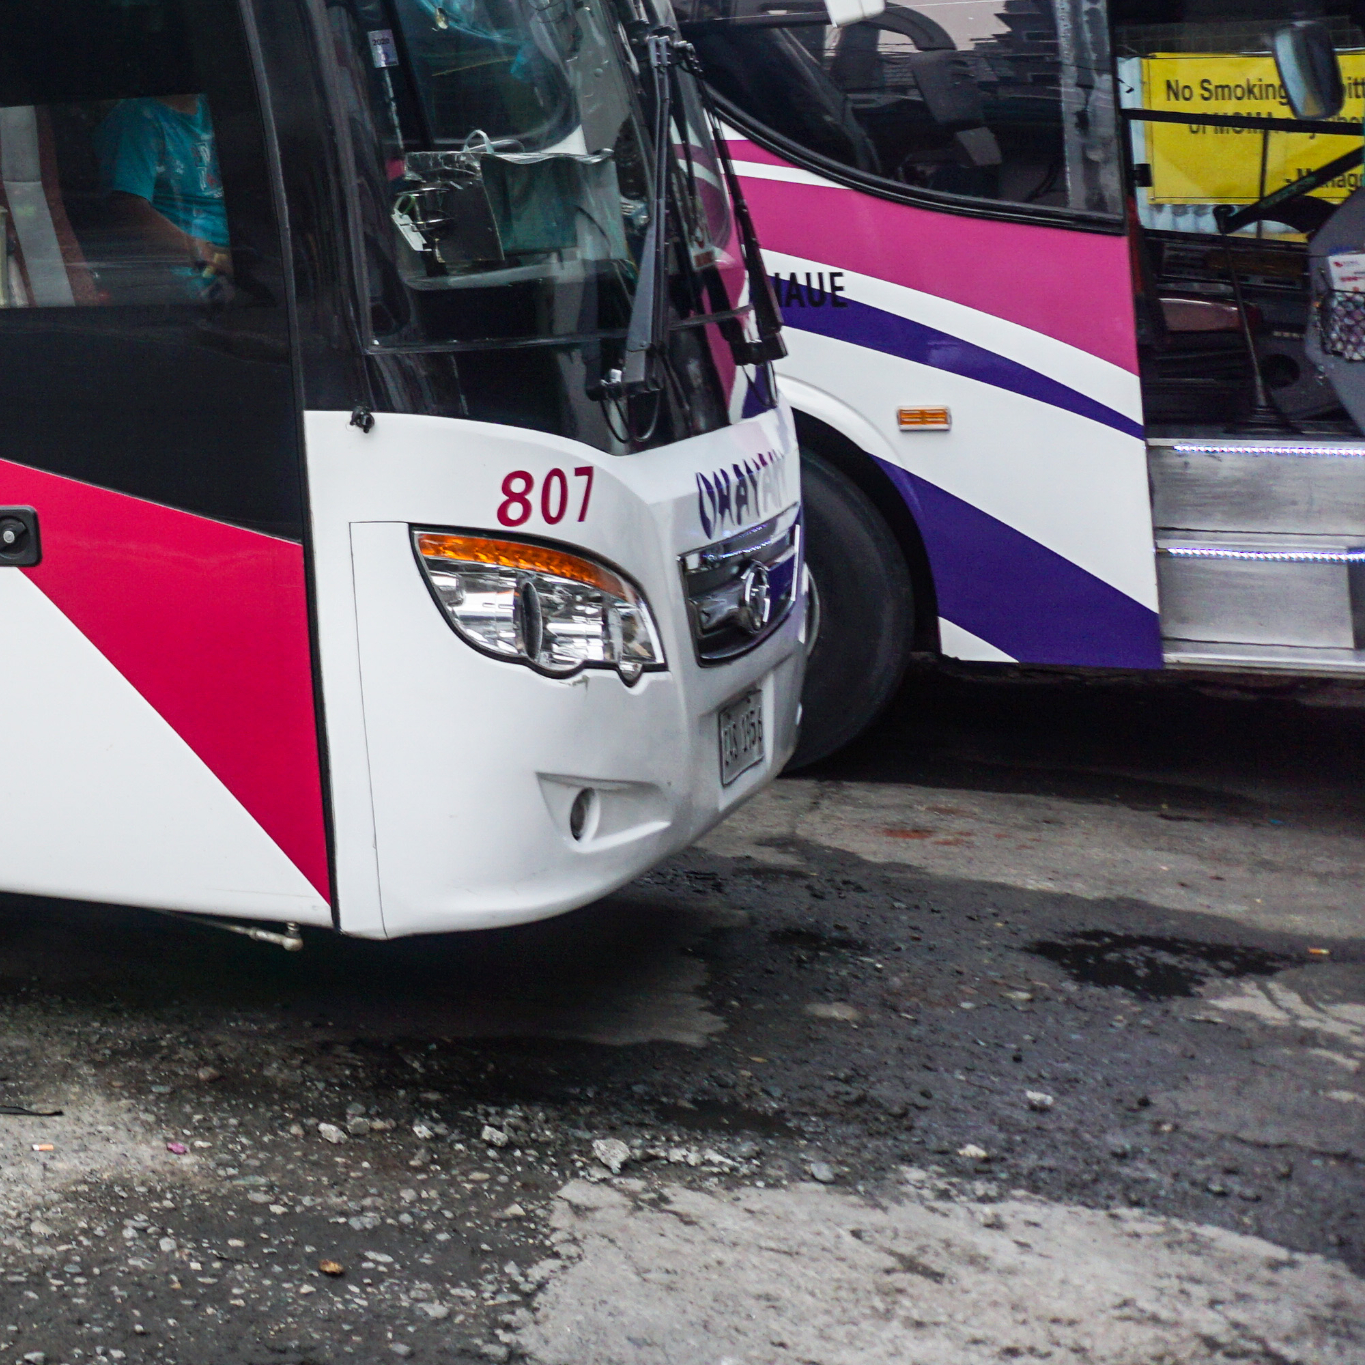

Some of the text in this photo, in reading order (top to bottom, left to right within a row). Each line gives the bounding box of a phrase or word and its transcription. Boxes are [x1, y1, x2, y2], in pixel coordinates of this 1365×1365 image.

[1165, 77, 1290, 106] No Smoking
[496, 465, 594, 527] 807
